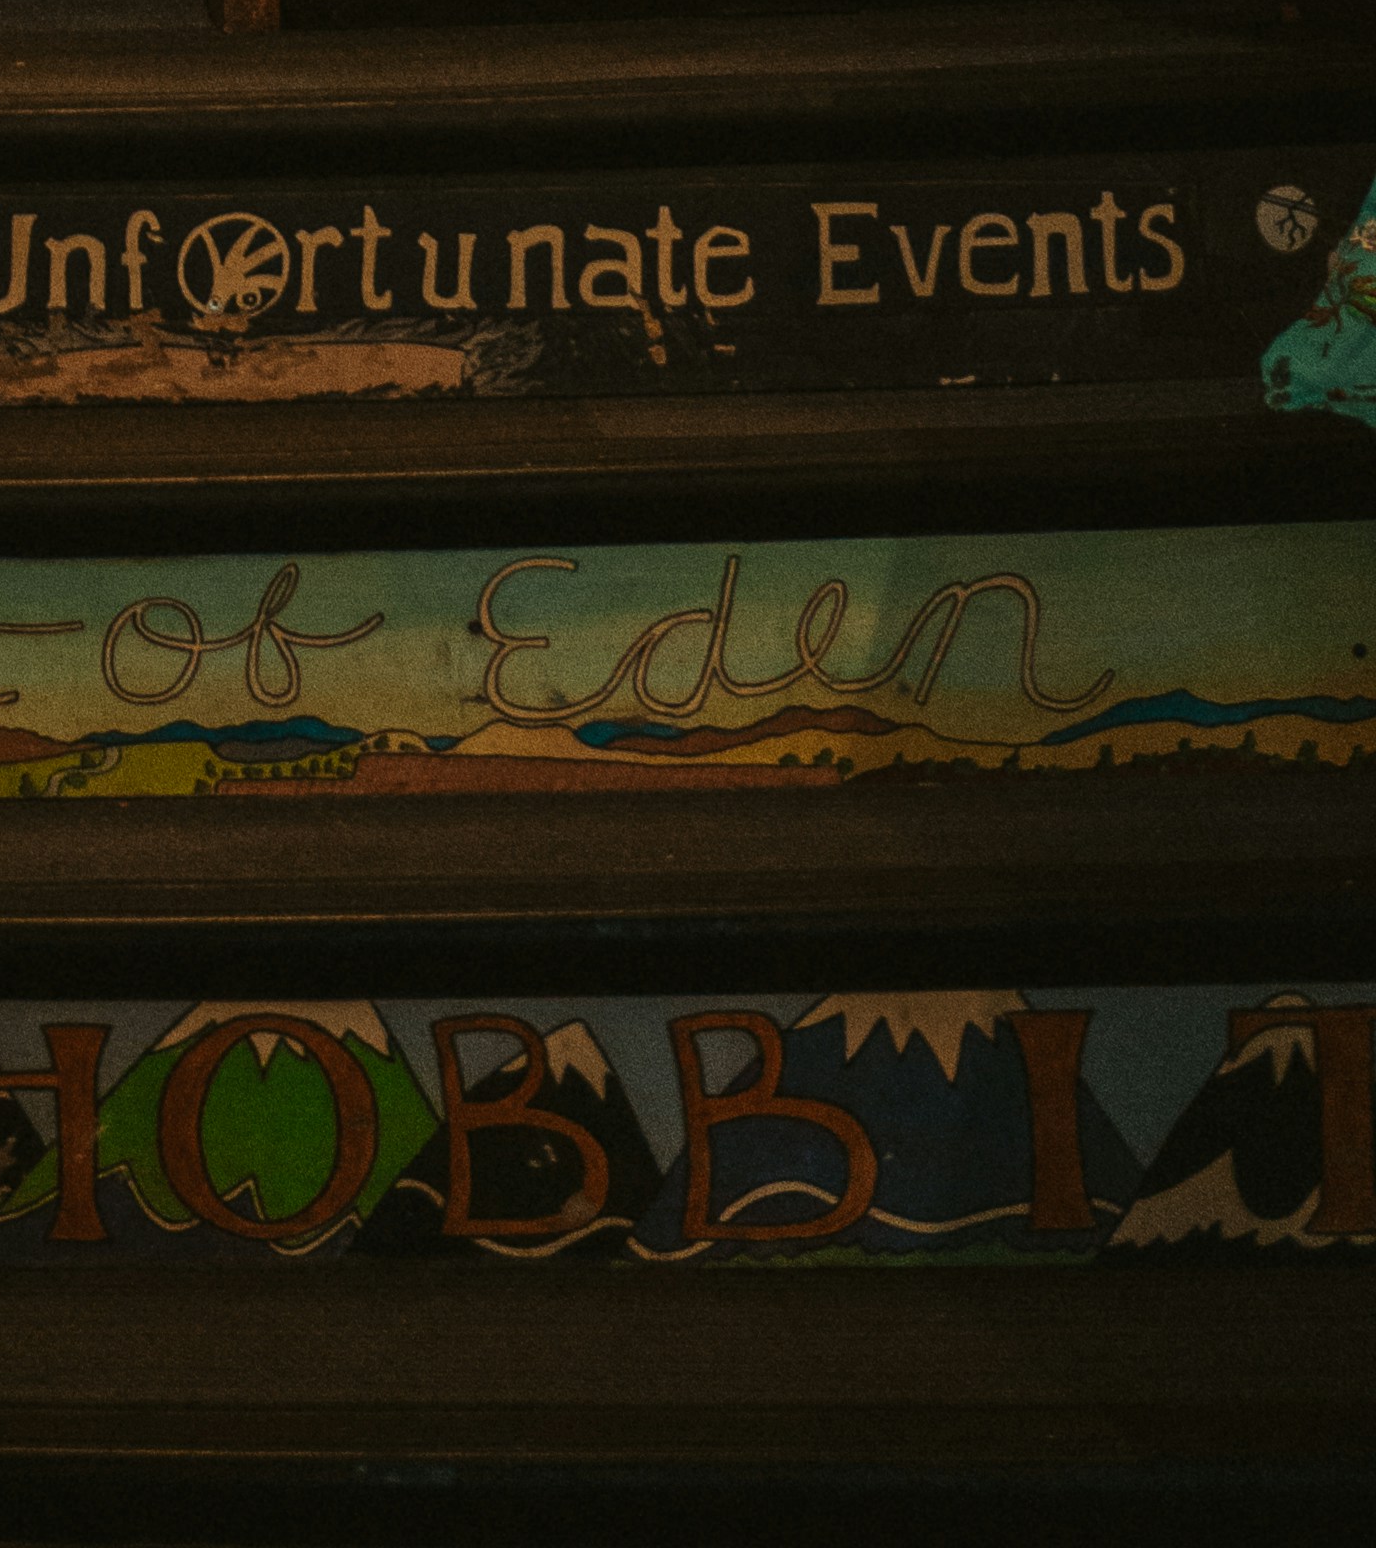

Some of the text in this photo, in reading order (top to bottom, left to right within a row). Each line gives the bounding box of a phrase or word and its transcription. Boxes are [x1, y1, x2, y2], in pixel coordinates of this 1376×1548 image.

[815, 186, 1187, 307] Events
[98, 564, 385, 707] of
[476, 556, 1115, 719] Eden
